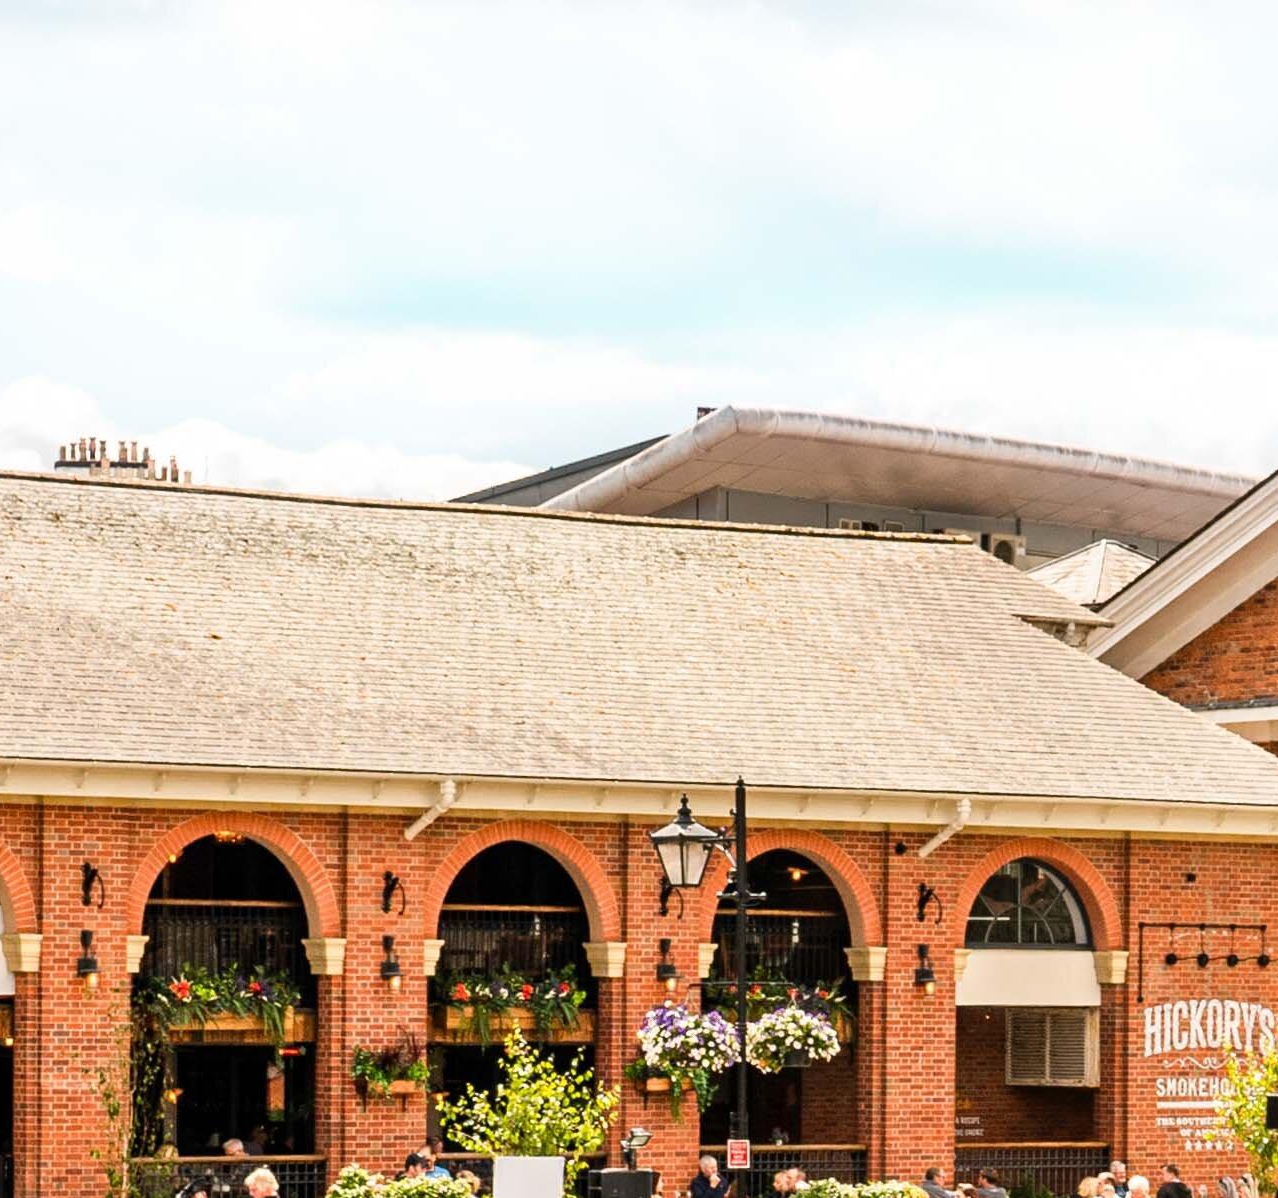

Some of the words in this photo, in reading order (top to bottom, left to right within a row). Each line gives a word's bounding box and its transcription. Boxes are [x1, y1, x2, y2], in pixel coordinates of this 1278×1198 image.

[1144, 999, 1276, 1057] HICKORY'S
[1156, 1077, 1253, 1098] SMOKEHO
[1176, 1117, 1226, 1127] SOUTHEN
